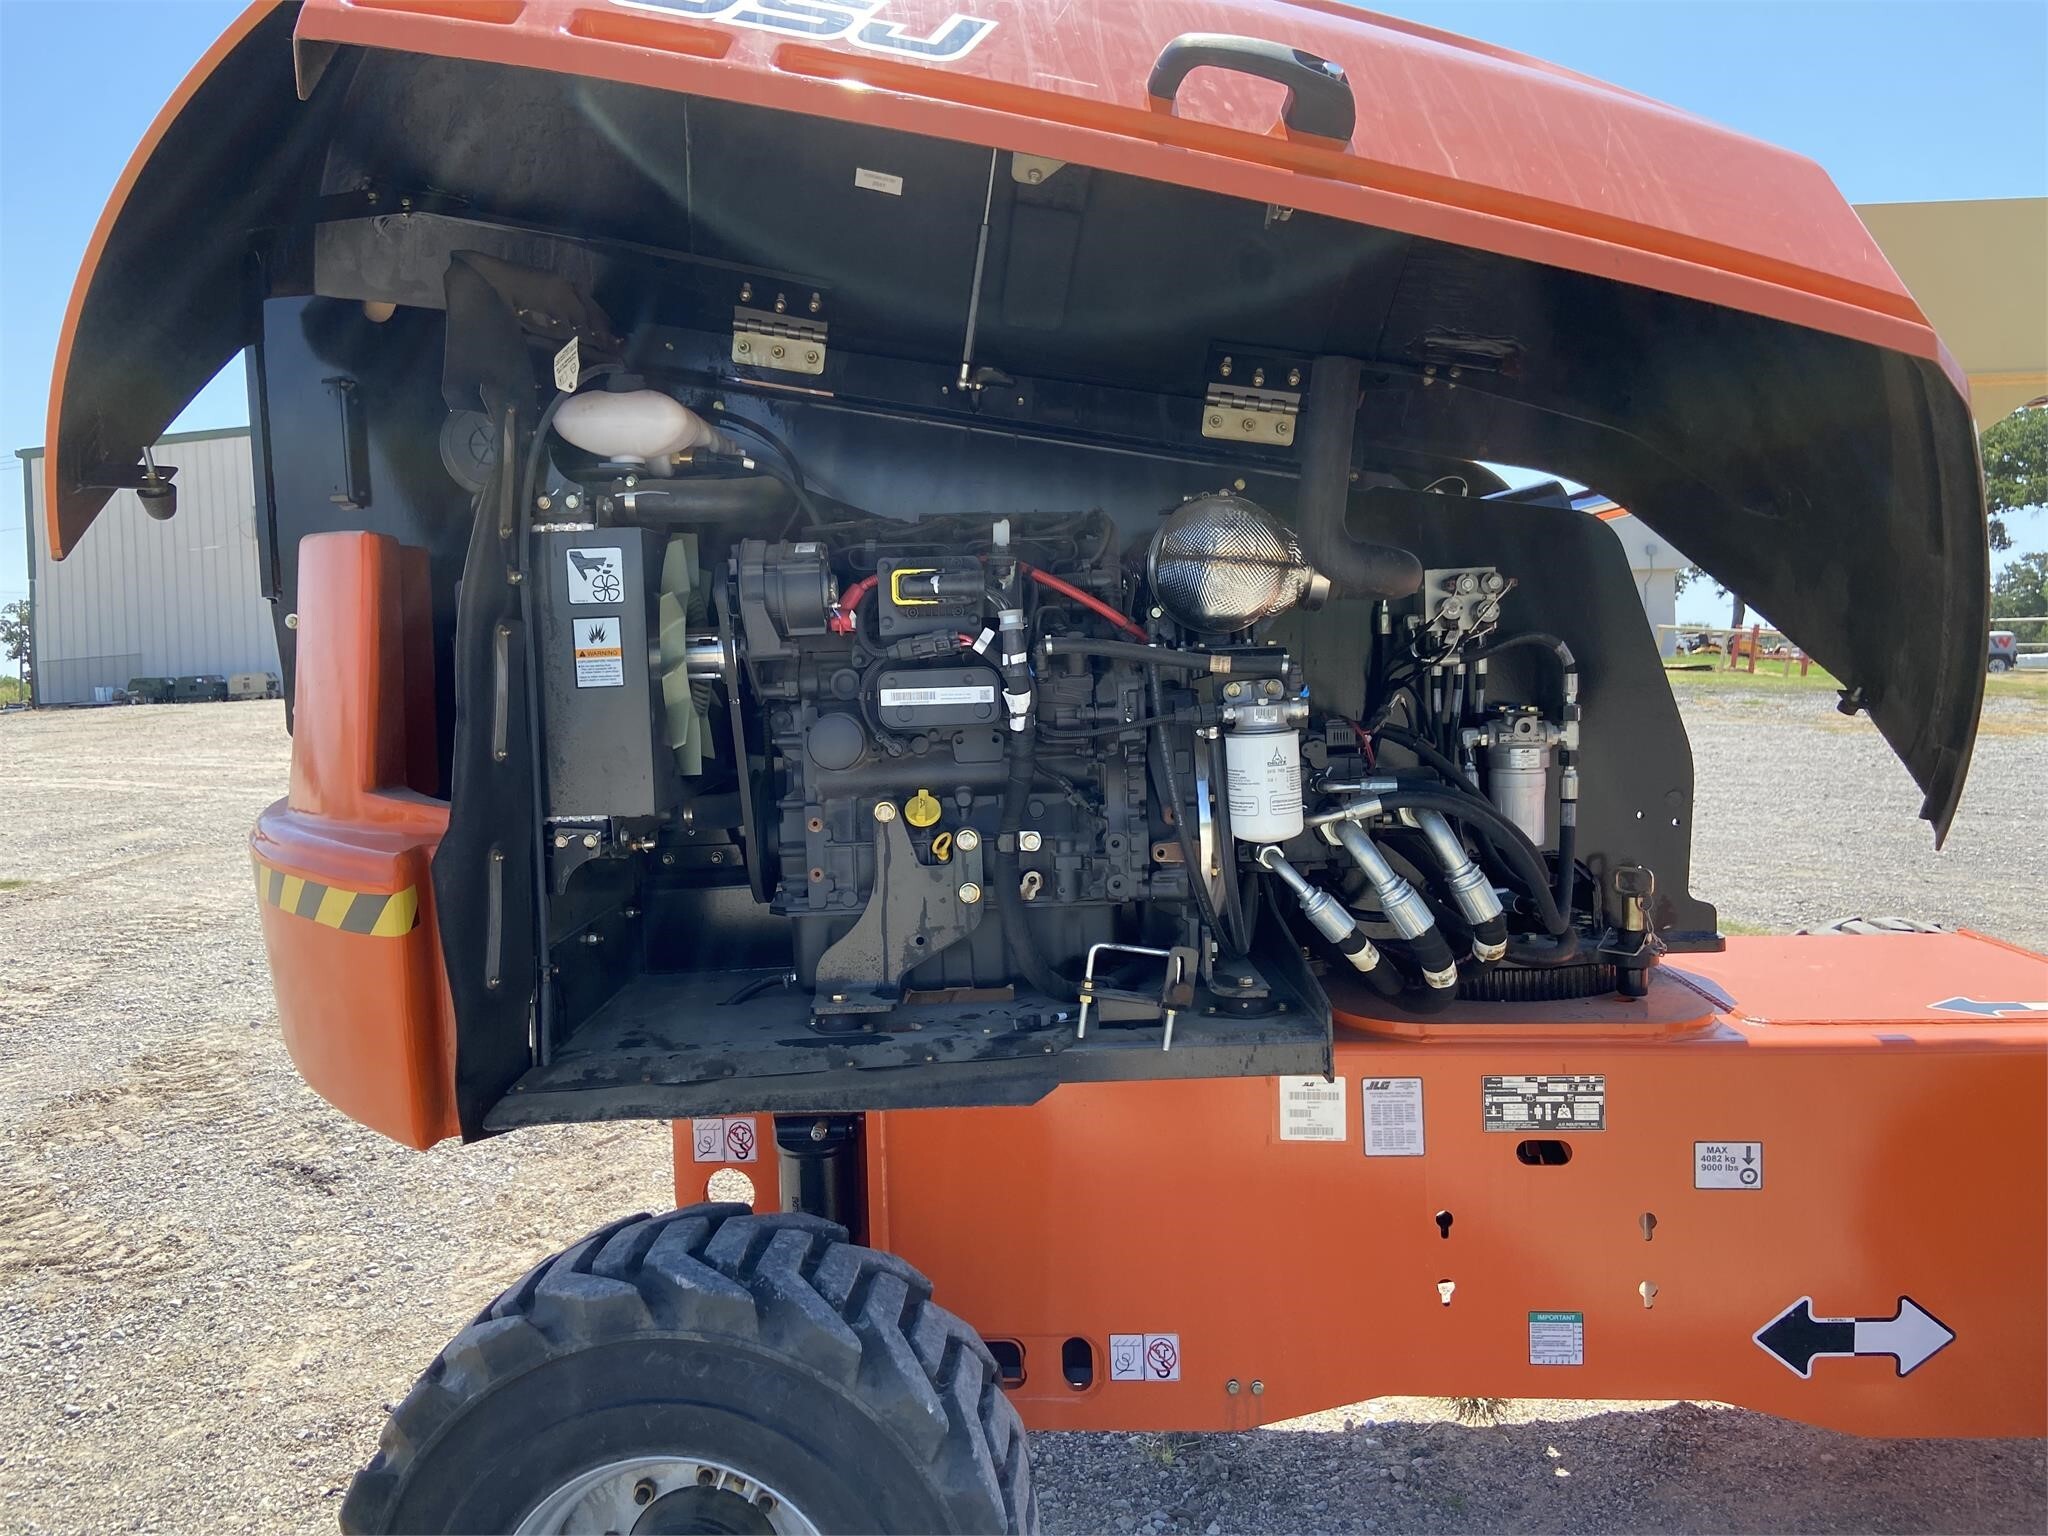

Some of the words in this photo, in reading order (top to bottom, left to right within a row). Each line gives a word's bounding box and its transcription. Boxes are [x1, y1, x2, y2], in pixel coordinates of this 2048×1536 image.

[1365, 1081, 1391, 1090] JLG
[1706, 1146, 1728, 1154] MAX
[1700, 1155, 1722, 1163] 4082
[1724, 1155, 1736, 1164] kg
